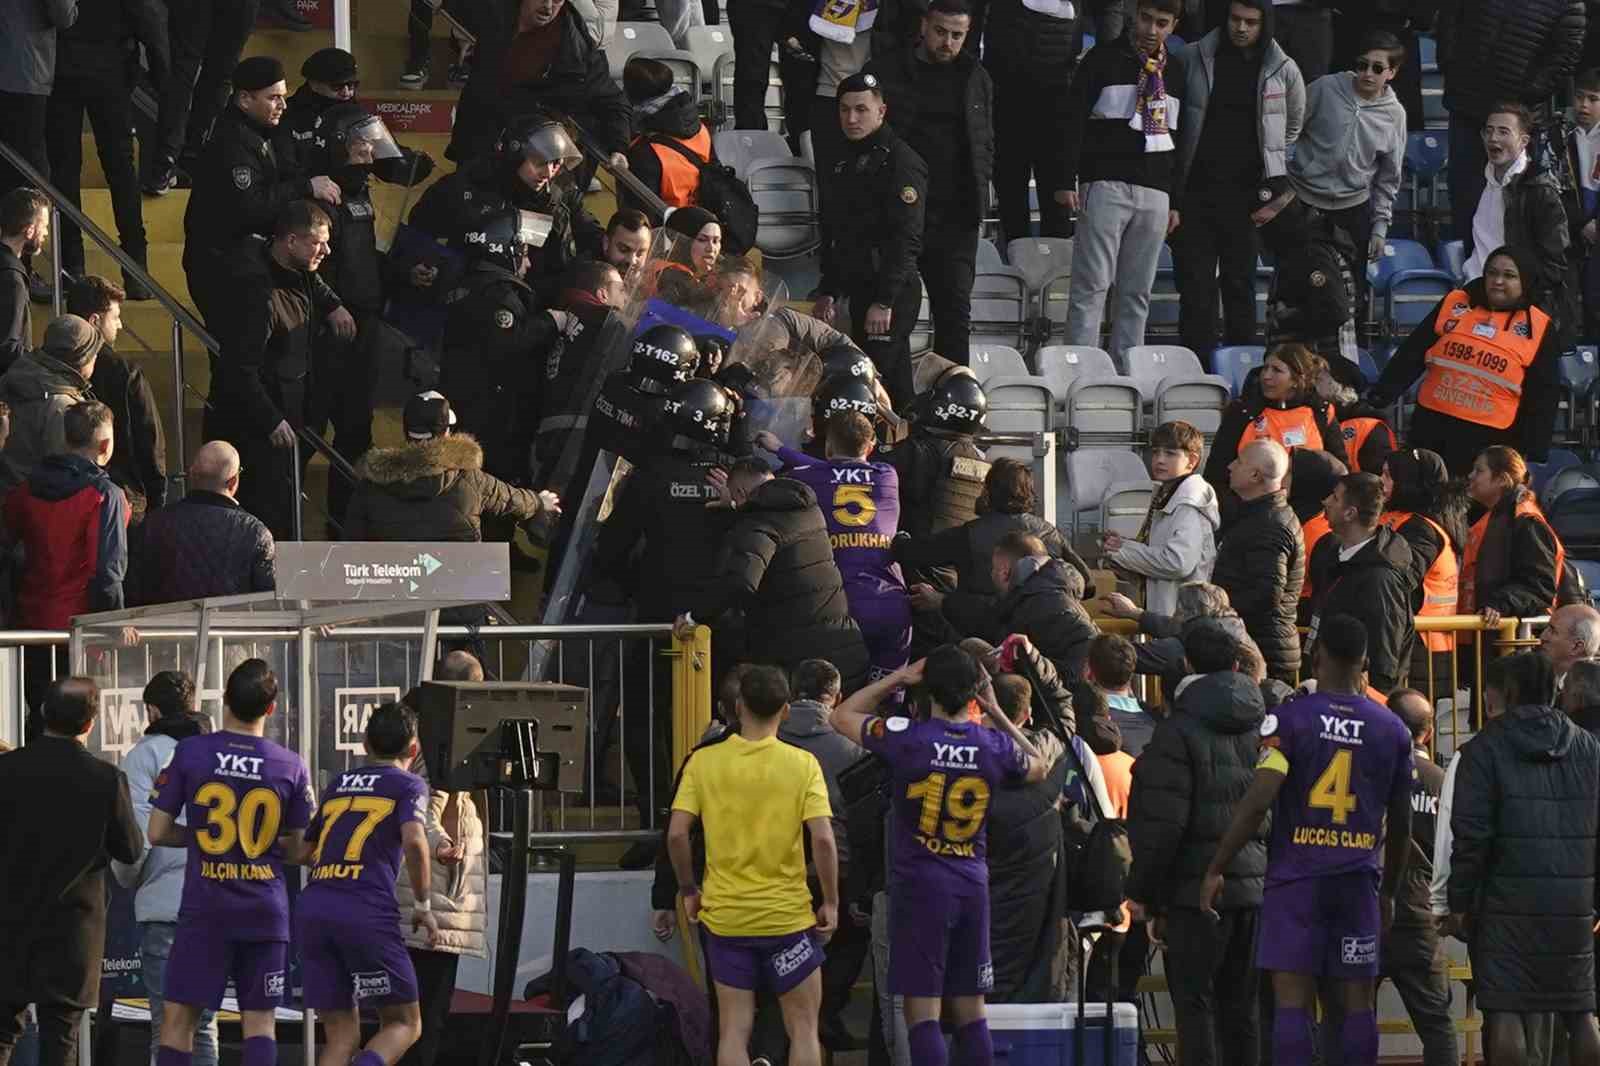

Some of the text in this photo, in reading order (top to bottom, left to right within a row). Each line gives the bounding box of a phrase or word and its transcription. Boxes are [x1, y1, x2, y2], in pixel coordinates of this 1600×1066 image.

[488, 242, 504, 254] 34
[1443, 341, 1509, 373] 1598-1099
[831, 468, 874, 483] YKT
[670, 481, 701, 497] ÖZEL
[832, 484, 878, 528] 5
[344, 563, 421, 577] Türk Telekom
[1319, 714, 1365, 737] YKT
[215, 752, 265, 773] YKT
[933, 742, 979, 762] YKT
[341, 774, 382, 787] YKT
[1308, 748, 1357, 824] 4
[905, 772, 990, 842] 19
[194, 782, 281, 859] 30
[312, 795, 397, 861] 77
[1293, 826, 1338, 848] LUCCAS
[103, 957, 142, 972] Telekom
